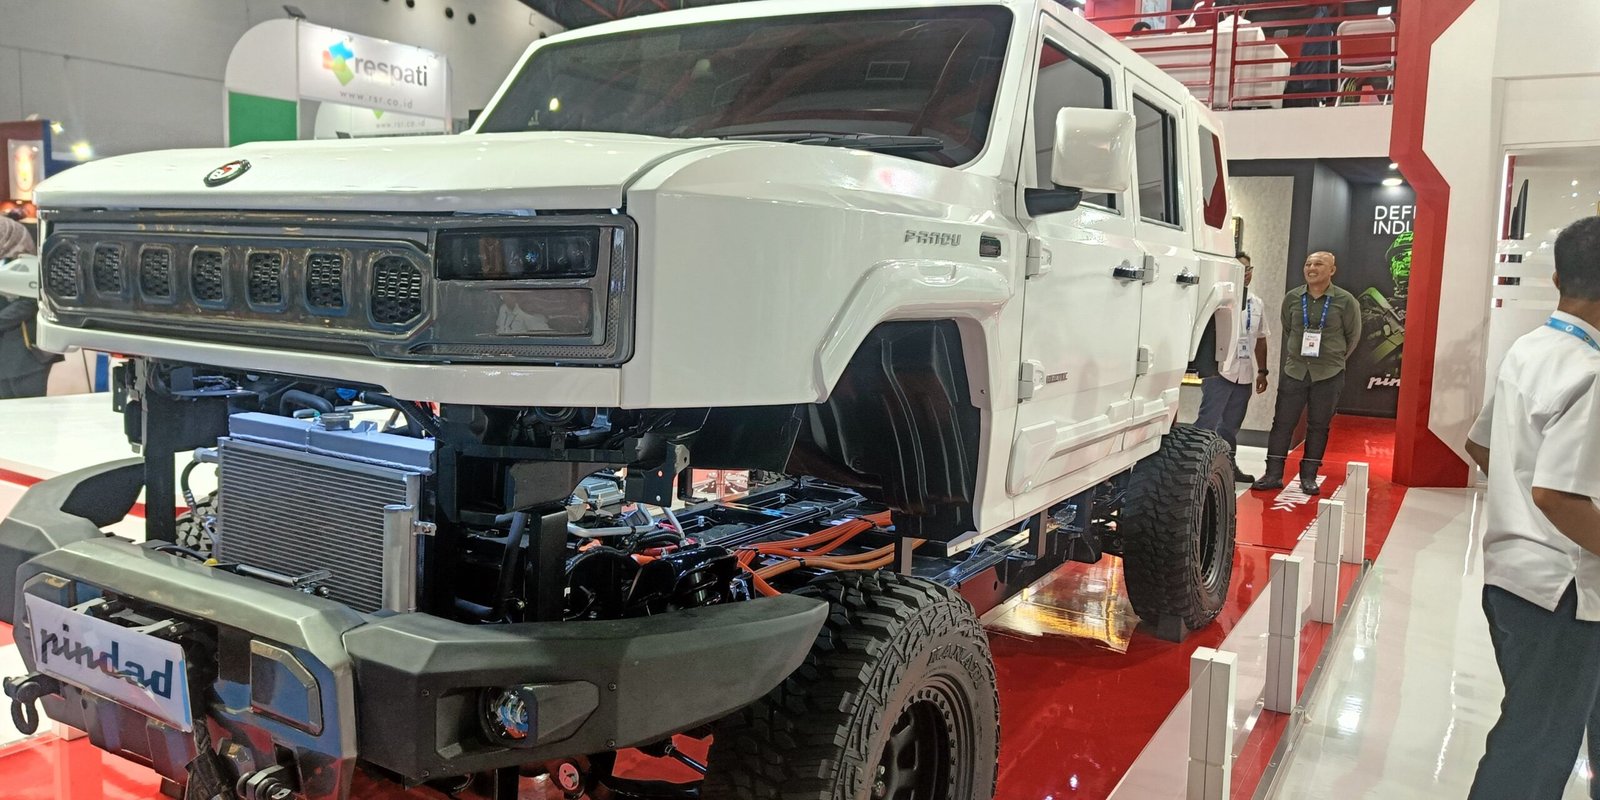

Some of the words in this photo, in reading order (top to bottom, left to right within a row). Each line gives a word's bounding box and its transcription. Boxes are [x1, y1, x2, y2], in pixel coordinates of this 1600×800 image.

[355, 57, 428, 87] respati
[339, 90, 413, 109] www.rsr.co.id
[40, 623, 174, 700] pindad
